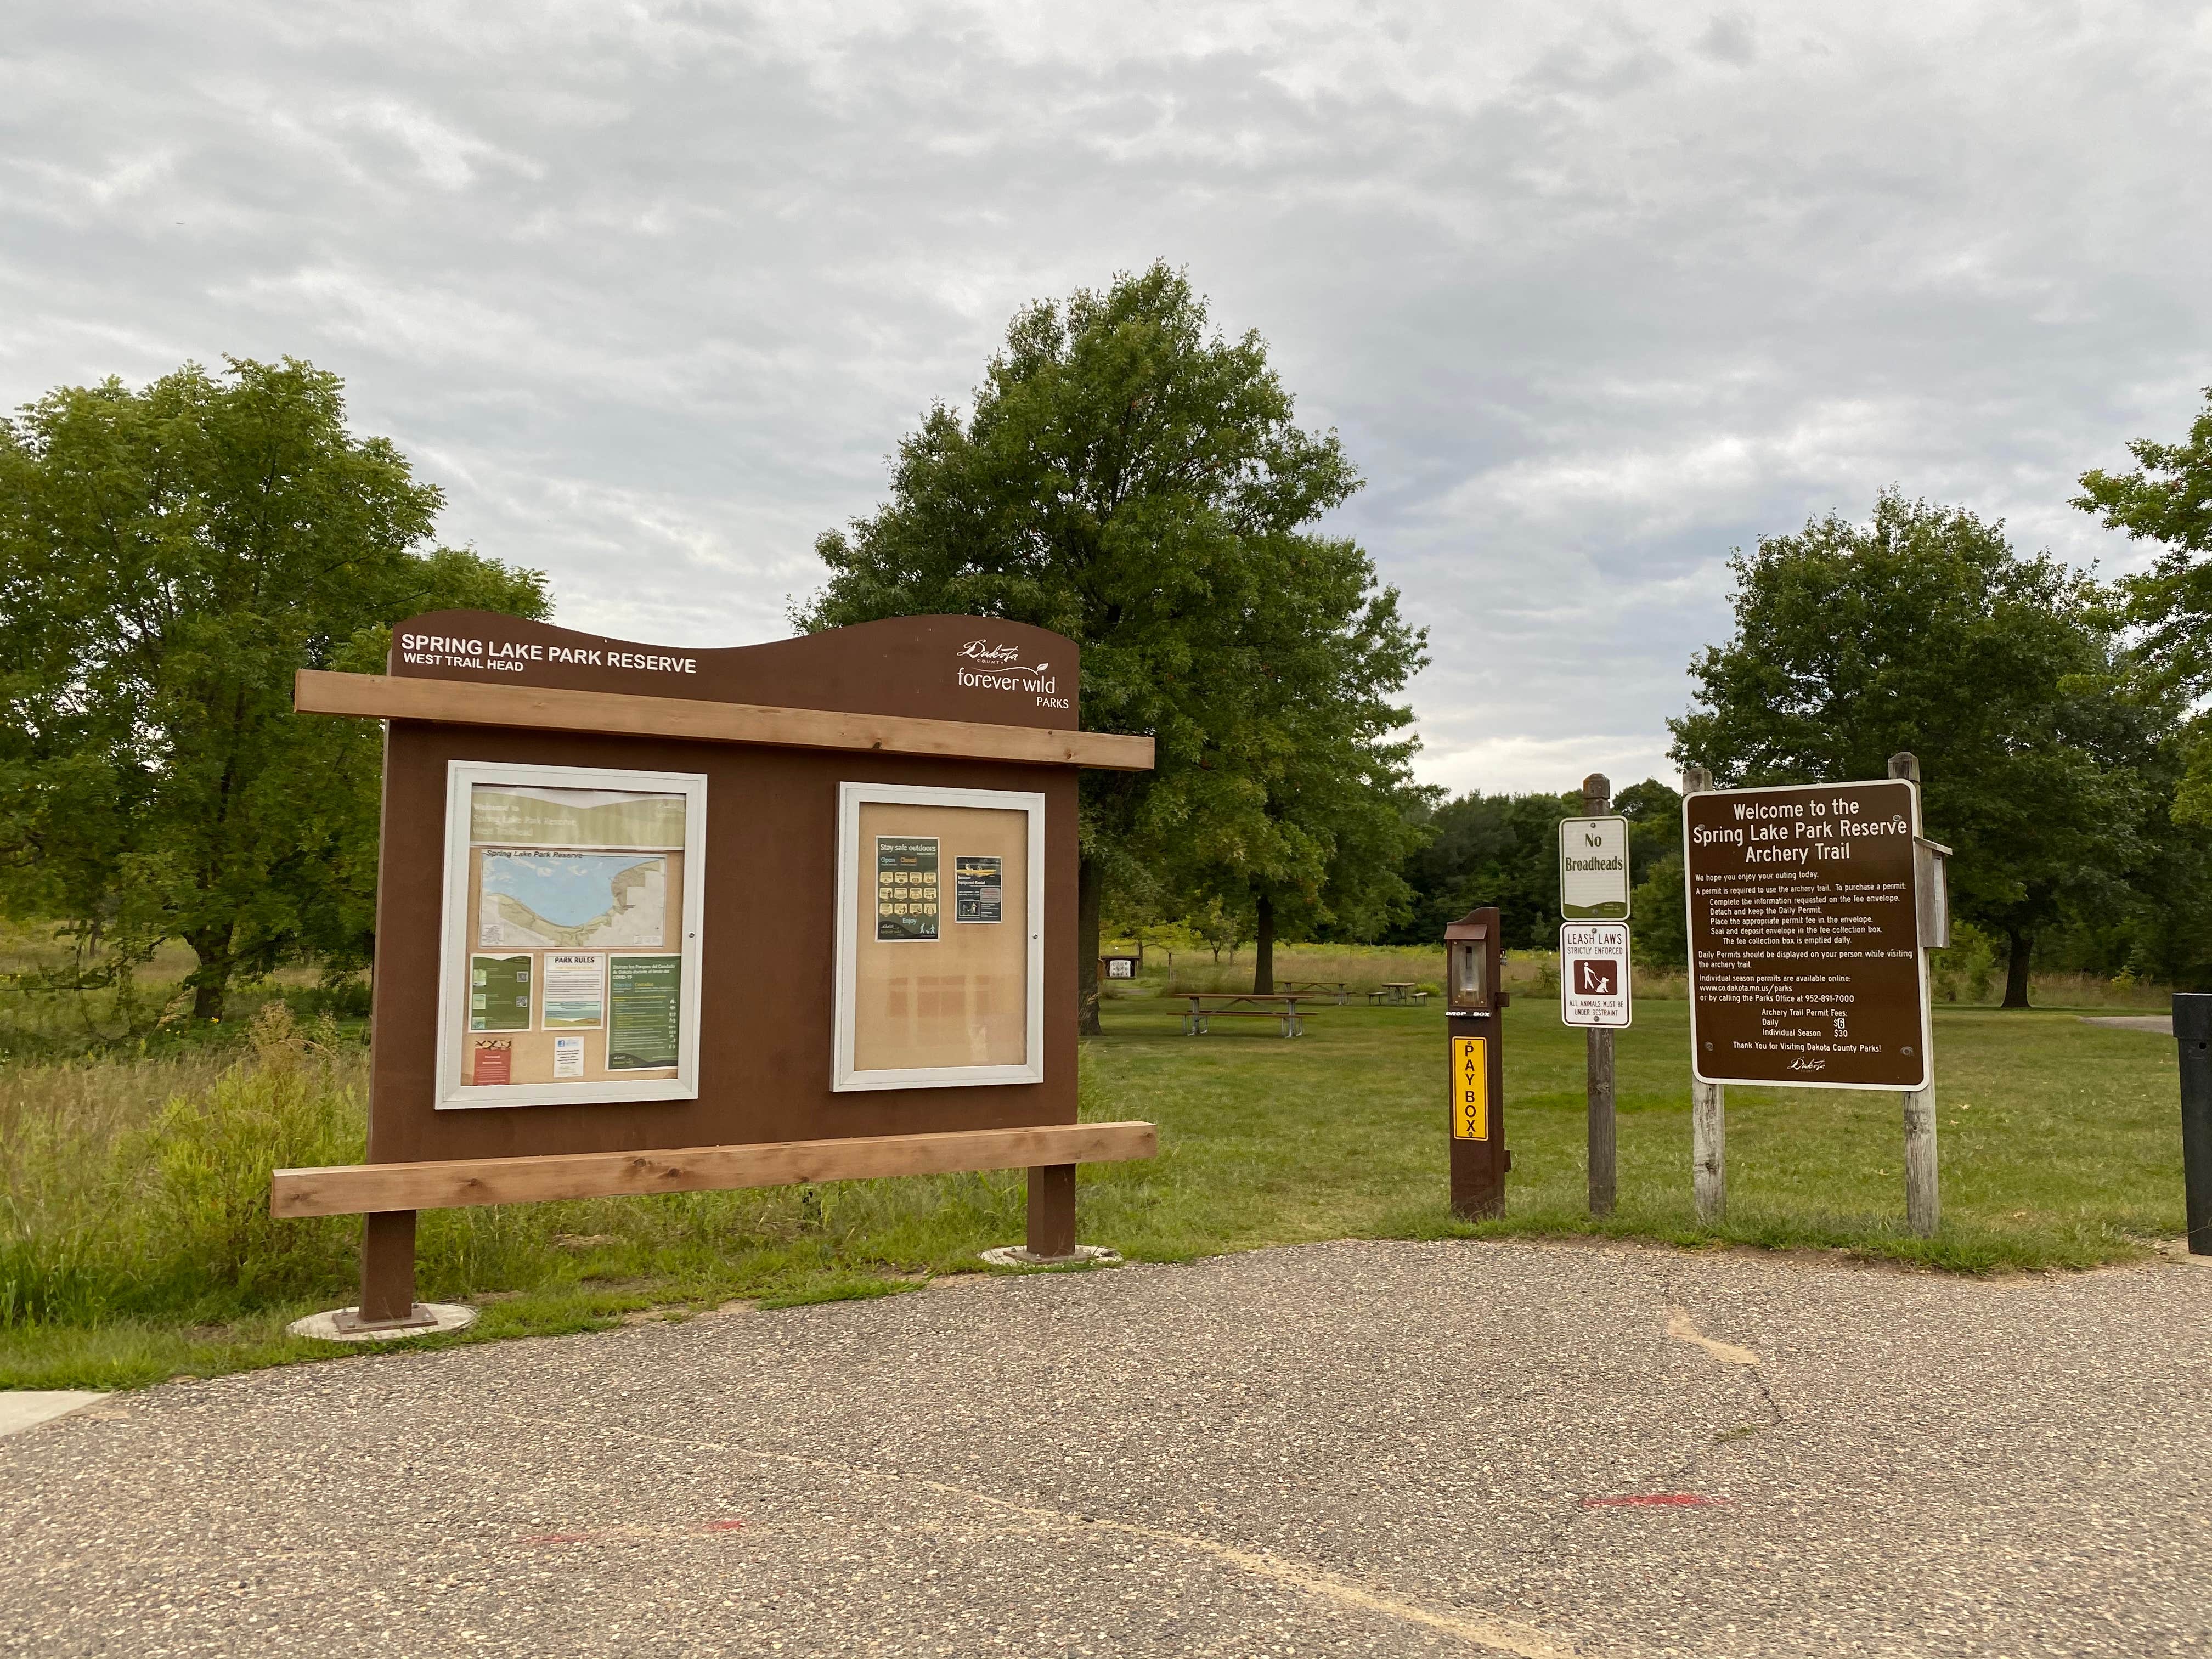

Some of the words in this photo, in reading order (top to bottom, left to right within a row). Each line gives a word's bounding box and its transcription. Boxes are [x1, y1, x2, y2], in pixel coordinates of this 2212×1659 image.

[401, 634, 483, 656] SPRING
[489, 641, 543, 660] LAKE
[549, 647, 601, 665] PARK
[607, 652, 697, 673] RESERVE
[956, 639, 1019, 662] Dakota
[403, 652, 442, 665] WEST
[445, 656, 484, 669] TRAIL
[487, 659, 523, 672] HEAD
[957, 667, 1019, 691] forever
[1022, 675, 1055, 694] wild
[1036, 697, 1069, 709] PARKS
[1734, 803, 1803, 820] Welcome
[1809, 800, 1825, 816] to
[1832, 798, 1859, 815] the
[1693, 826, 1743, 847] Spring
[1751, 824, 1788, 840] Lake
[1796, 821, 1833, 838] Park
[1840, 820, 1907, 837] Reserve
[1585, 833, 1602, 847] No
[880, 844, 894, 853] Stay
[1746, 845, 1809, 865] Archery
[1815, 842, 1850, 860] Trail
[1566, 856, 1623, 871] Broadheads
[1738, 873, 1756, 882] enjoy
[1775, 871, 1796, 880] outing
[1799, 871, 1819, 879] today.
[1702, 887, 1722, 896] permit
[1730, 887, 1755, 895] required
[1791, 885, 1815, 893] archery
[1845, 883, 1874, 892] purchase
[1709, 898, 1740, 906] Complete
[1794, 896, 1826, 905] requested
[1866, 894, 1900, 903] envelope.
[1779, 907, 1795, 915] Daily
[1742, 917, 1779, 926] appropriate
[1781, 916, 1803, 925] permit
[1840, 916, 1872, 924] envelope.
[1740, 927, 1763, 935] deposit
[1567, 933, 1594, 944] LEASH
[1599, 934, 1622, 944] LAWS
[1804, 936, 1831, 945] emptied
[1833, 936, 1852, 945] daily.
[1699, 951, 1714, 960] Daily
[1776, 951, 1808, 959] displayed
[1886, 950, 1912, 959] visiting
[1711, 961, 1735, 969] archery
[1757, 974, 1781, 983] permits
[1700, 984, 1792, 994] www.co.dakota.mn.us/parks
[1709, 994, 1717, 1002] by
[1719, 994, 1740, 1003] calling
[1762, 1008, 1787, 1017] Archery
[1762, 1018, 1779, 1027] Daily
[1833, 1018, 1844, 1028] $6
[1797, 1029, 1821, 1037] Season
[1834, 1029, 1848, 1037] $30
[1780, 1042, 1804, 1052] Visiting
[1807, 1043, 1830, 1051] Dakota
[1832, 1043, 1857, 1053] County
[1860, 1044, 1881, 1052] Parks!
[1464, 1045, 1475, 1085] PAY
[1465, 1091, 1476, 1132] BOX
